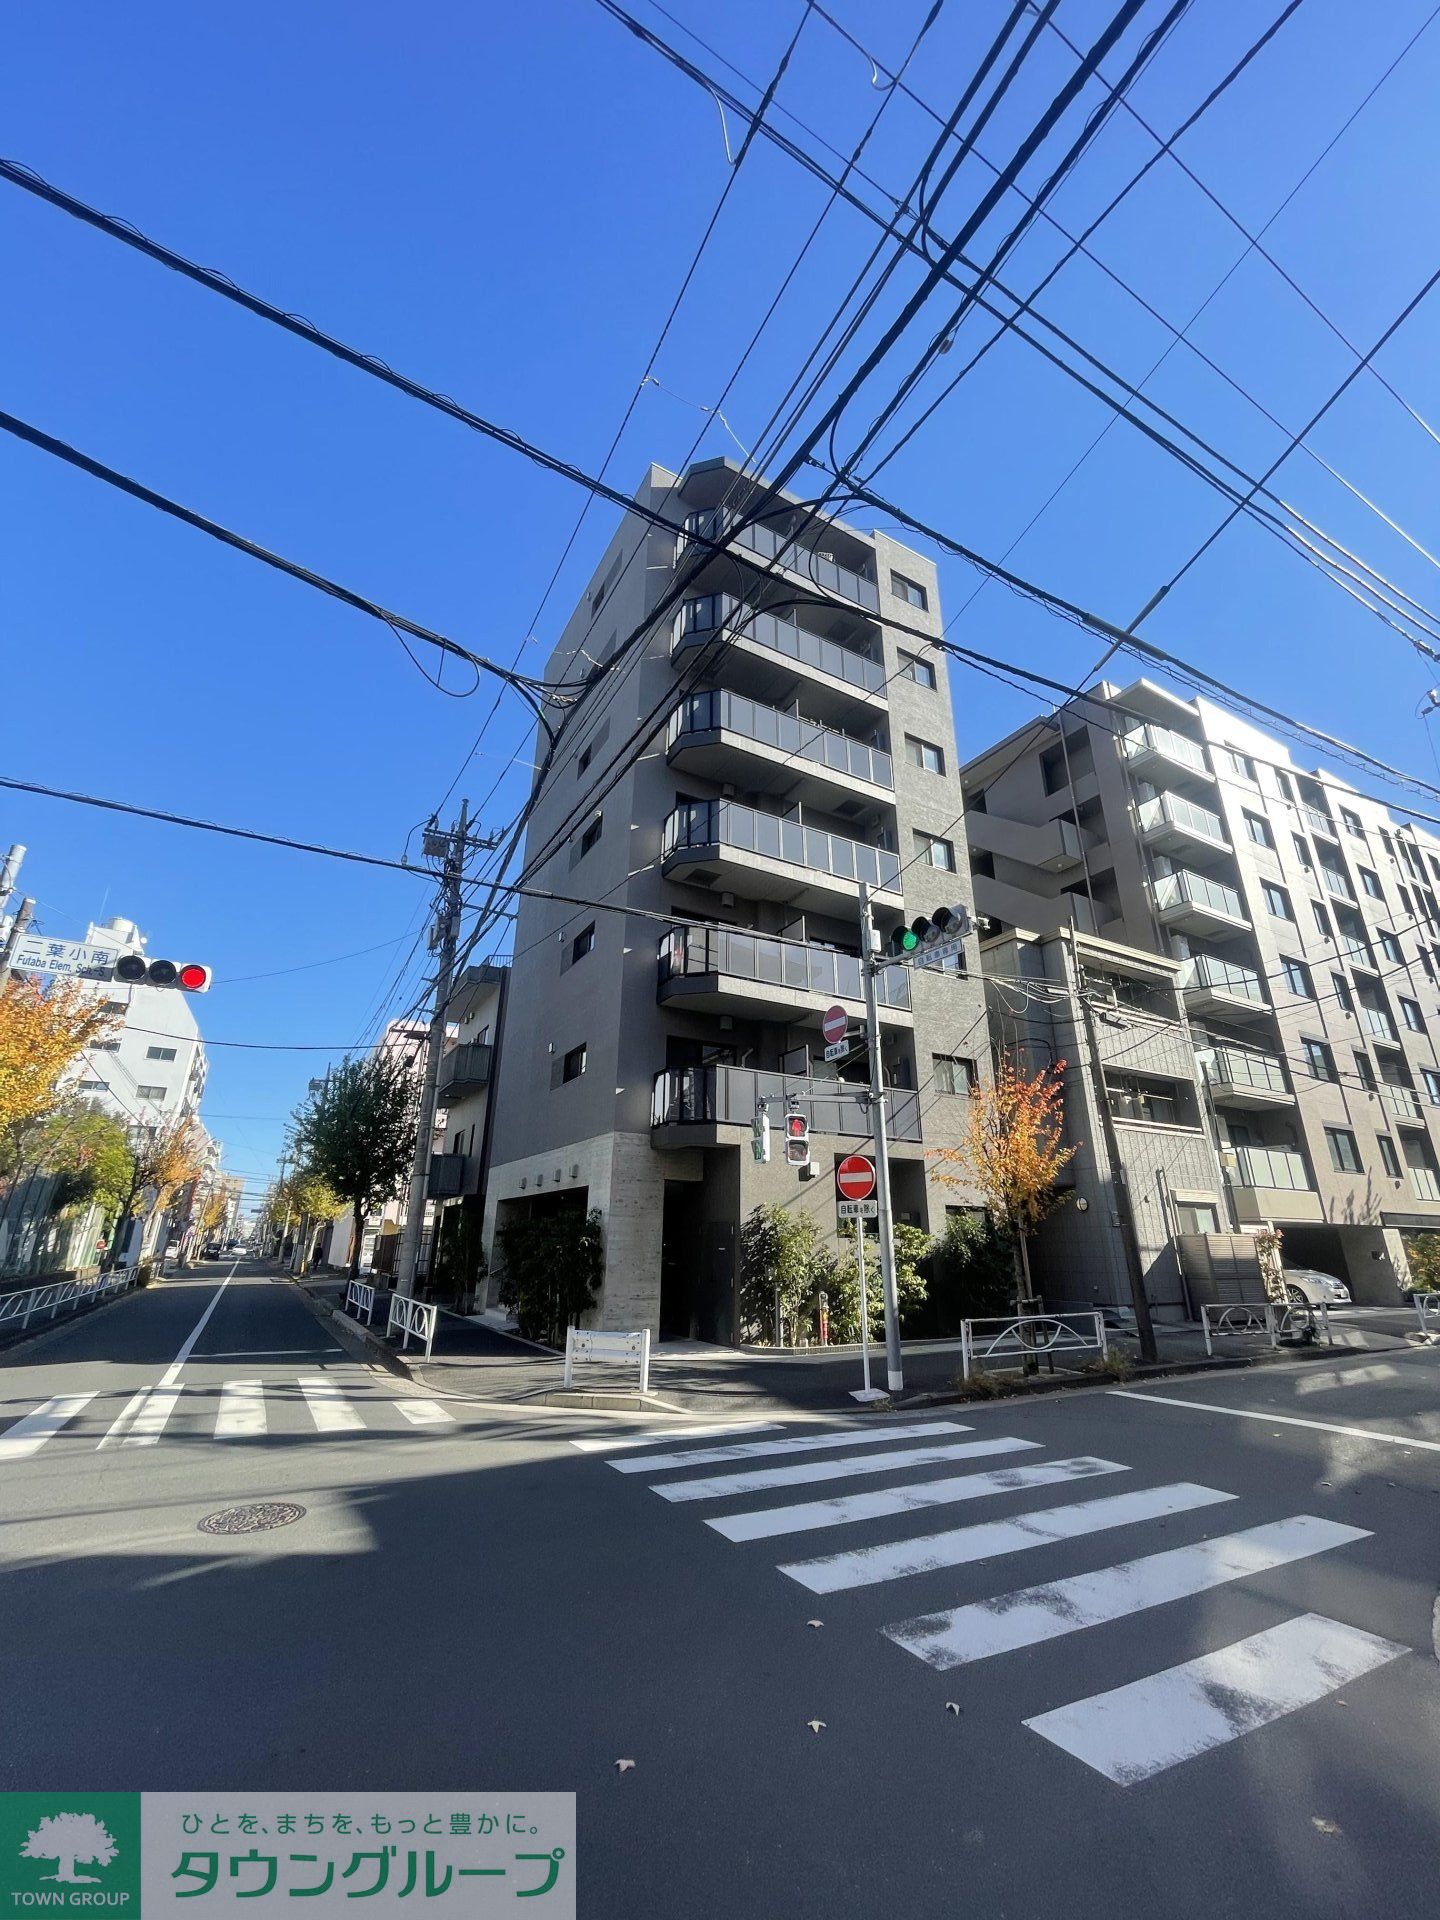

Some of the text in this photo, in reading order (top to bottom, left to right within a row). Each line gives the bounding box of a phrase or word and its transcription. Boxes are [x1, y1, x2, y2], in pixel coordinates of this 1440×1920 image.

[22, 940, 110, 966] 二葉小南
[17, 954, 46, 968] Futaba
[49, 959, 72, 973] Elem.
[840, 1203, 876, 1215] 自転車を除く
